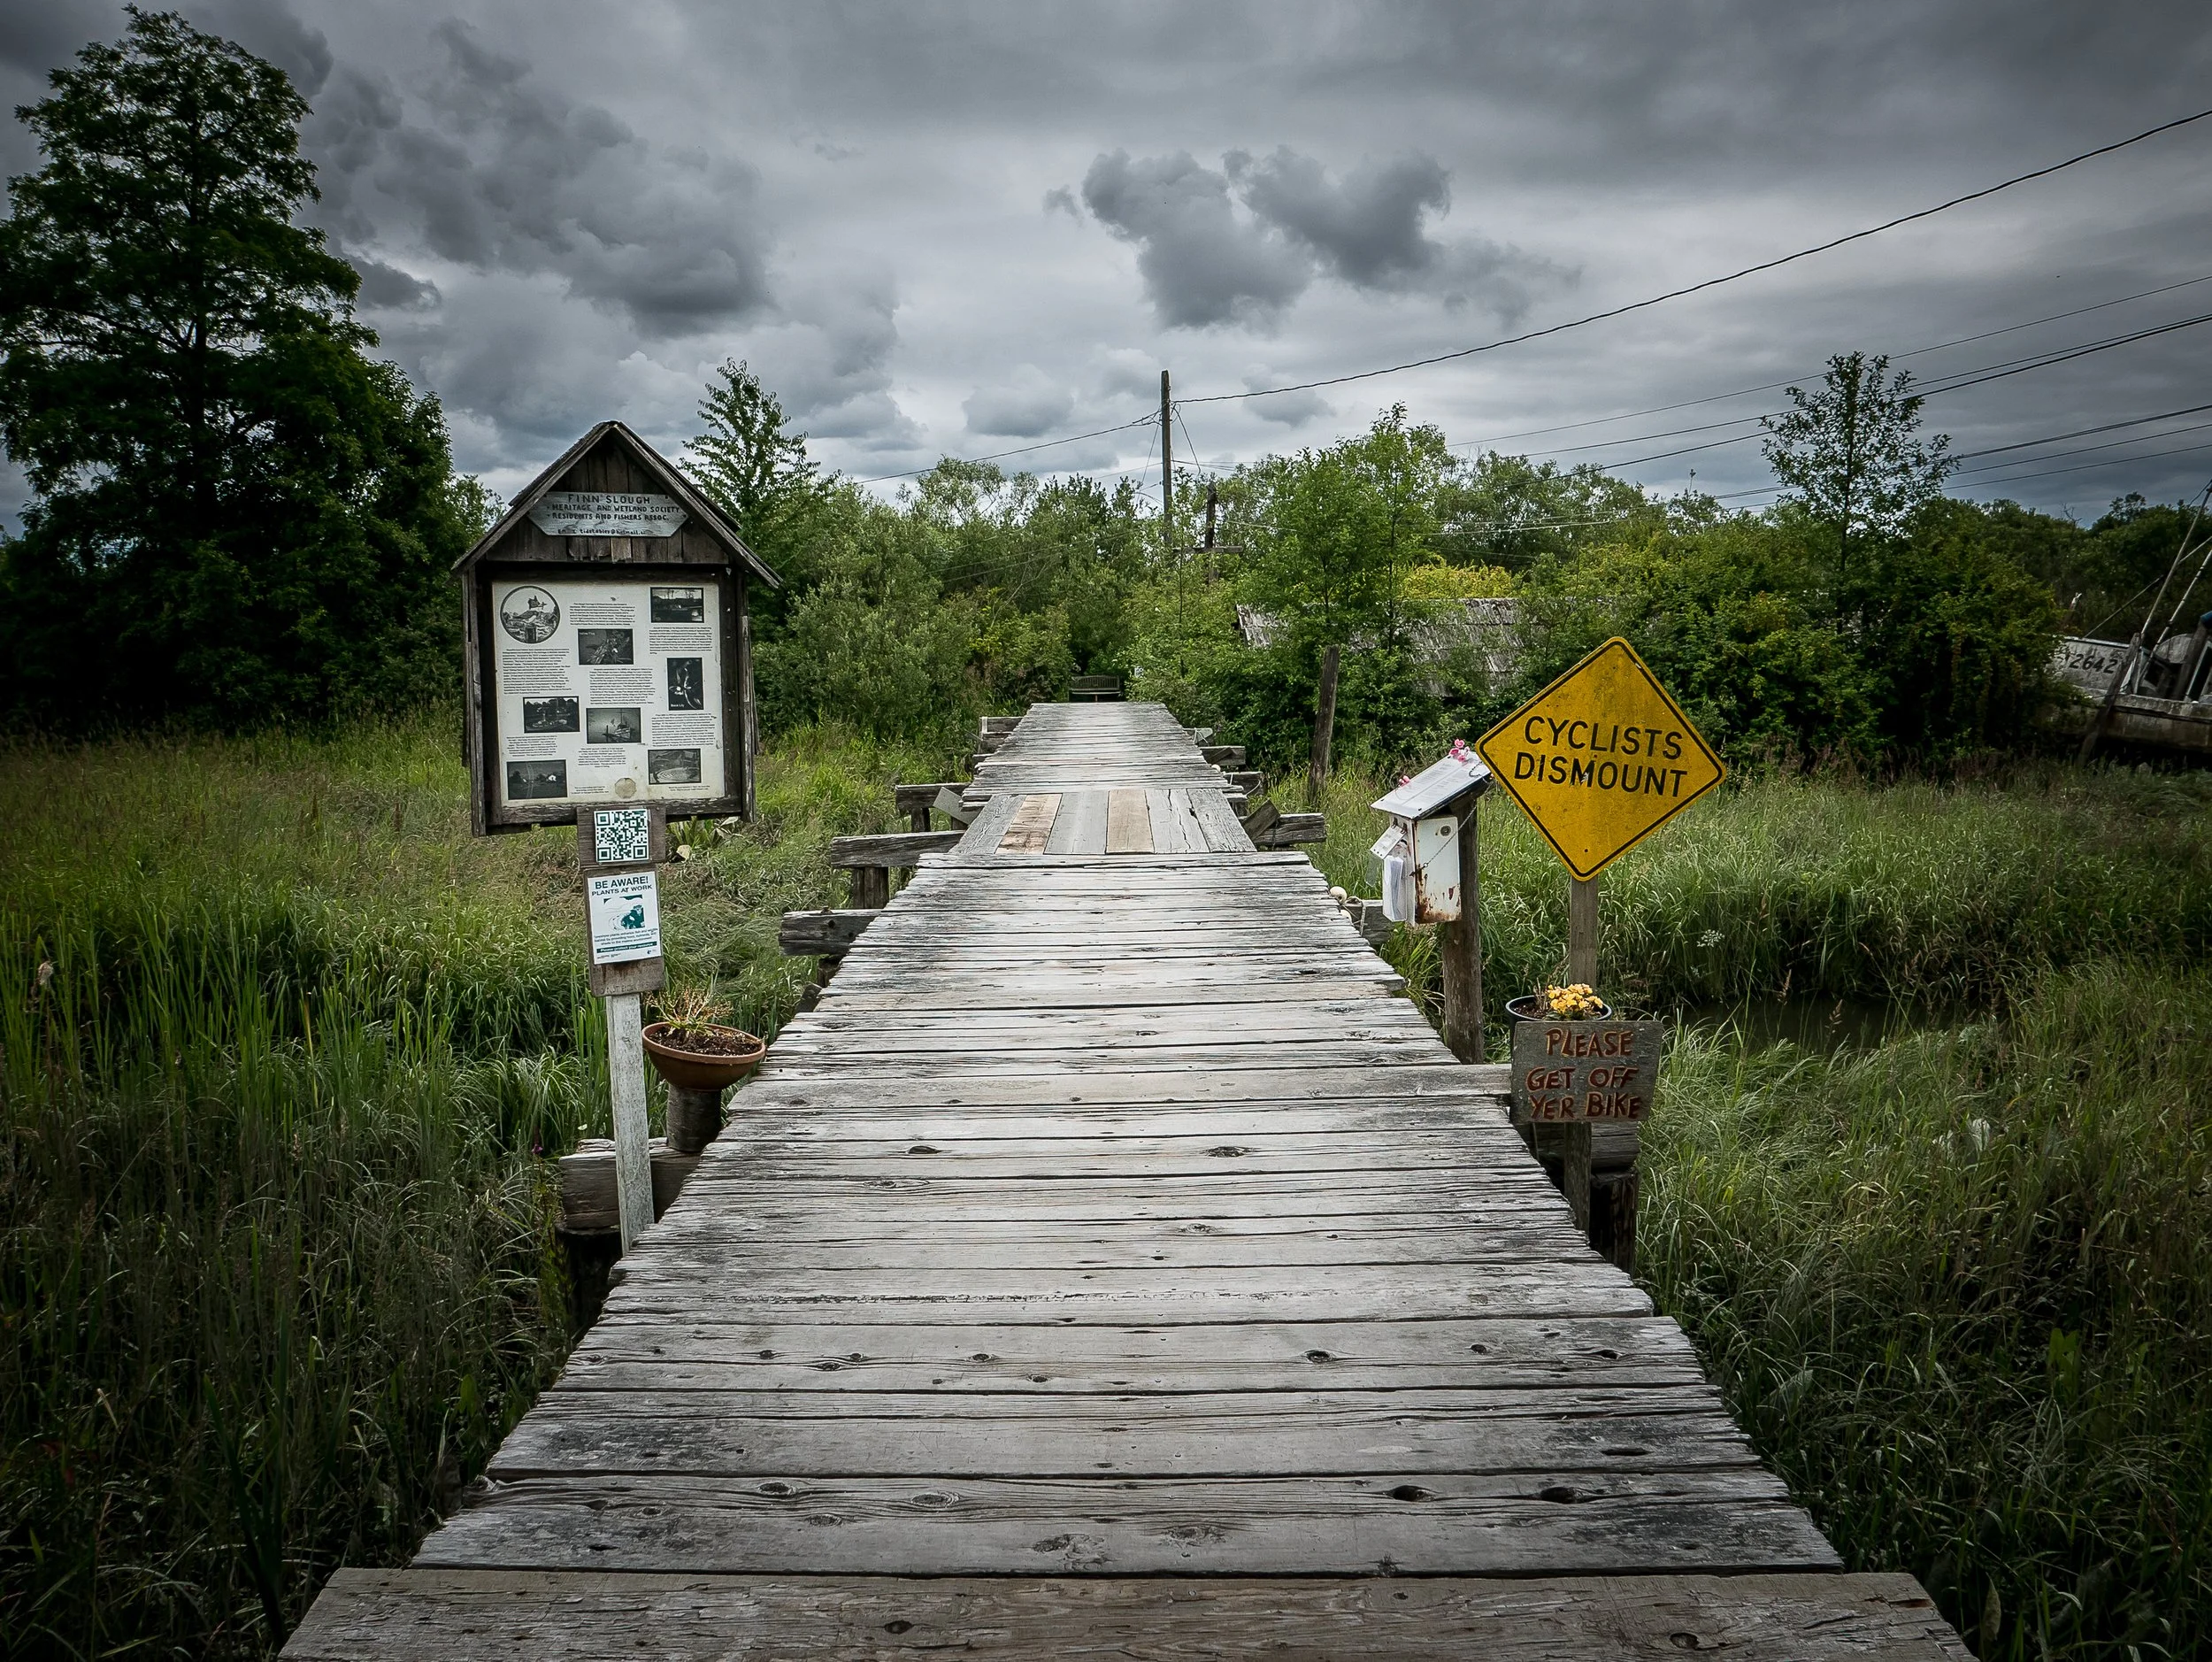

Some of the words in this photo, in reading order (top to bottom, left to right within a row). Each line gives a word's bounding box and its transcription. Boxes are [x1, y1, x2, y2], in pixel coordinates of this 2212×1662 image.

[568, 494, 600, 504] FINN
[605, 496, 650, 504] SLOUGH
[1524, 715, 1683, 760] CYCLISTS
[1514, 751, 1688, 797] DISMOUNT
[595, 881, 609, 889] BE
[611, 876, 649, 888] AWARE!
[1546, 1027, 1634, 1058] PLEASE
[1526, 1066, 1576, 1092] GET
[1588, 1066, 1640, 1089] OFF
[1529, 1095, 1575, 1120] YER
[1586, 1091, 1643, 1120] BIKE
